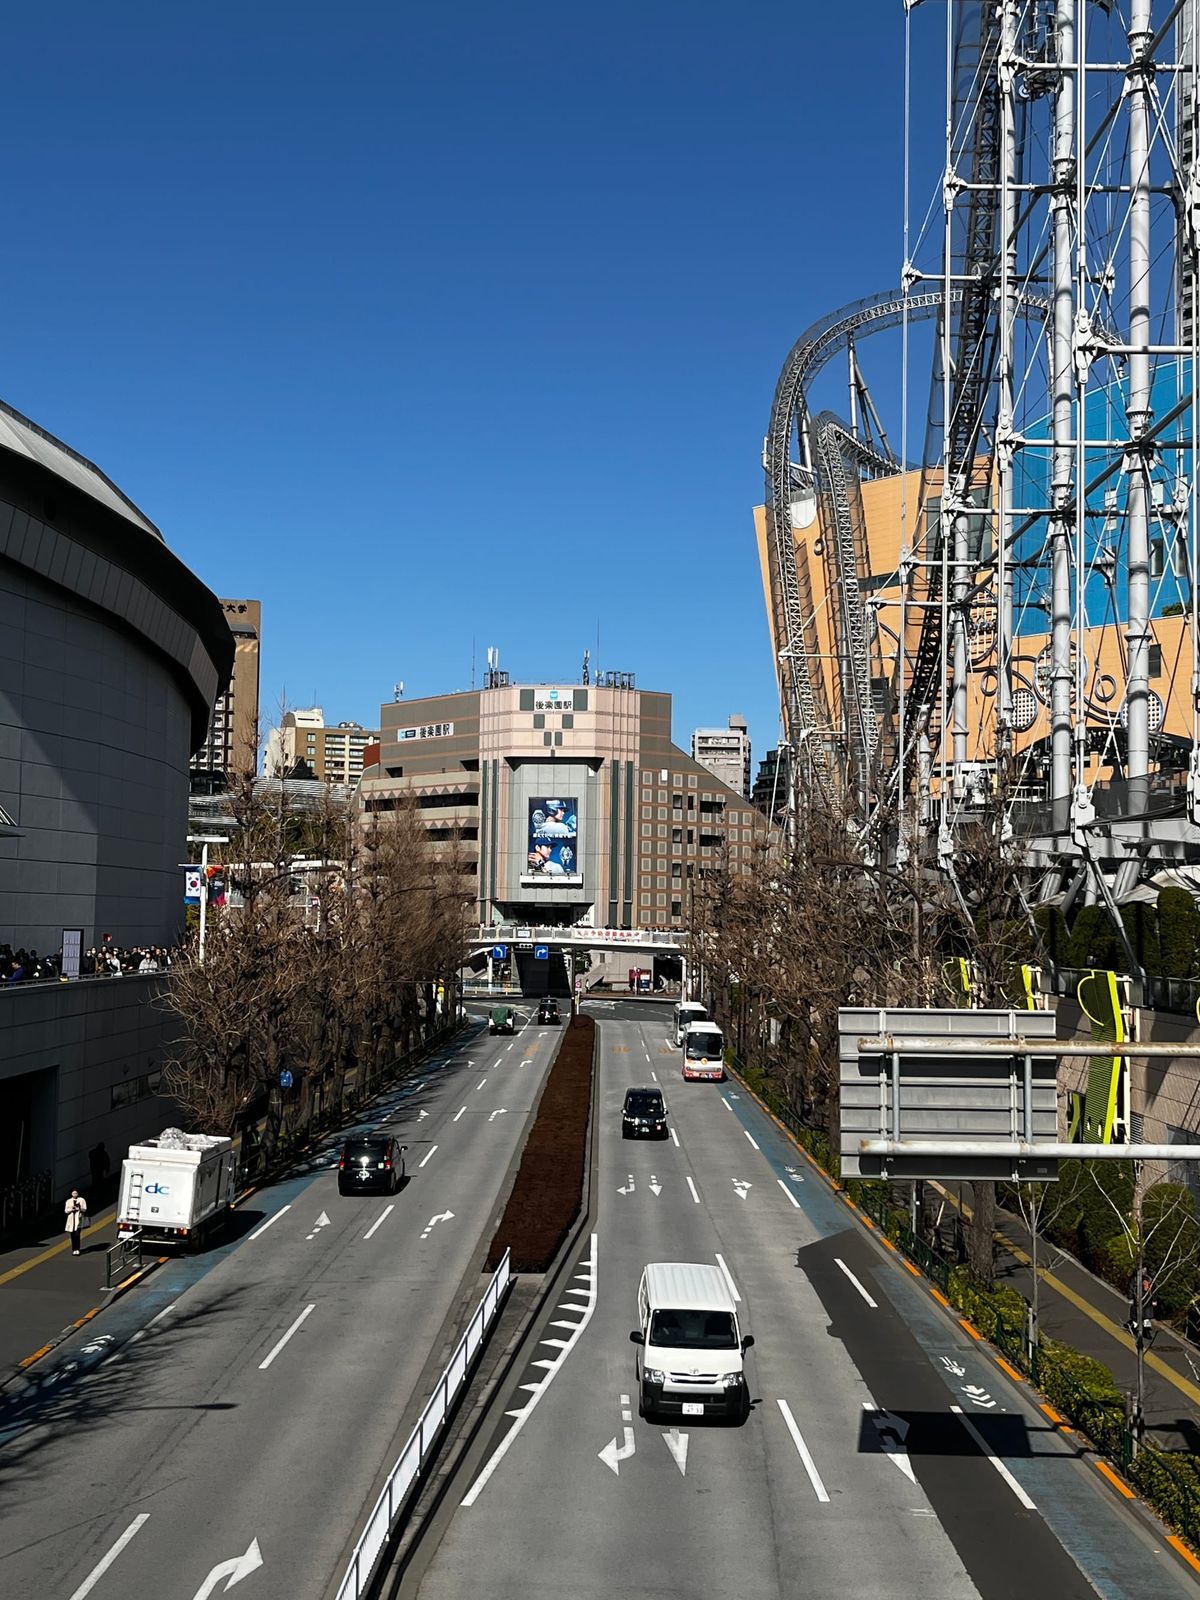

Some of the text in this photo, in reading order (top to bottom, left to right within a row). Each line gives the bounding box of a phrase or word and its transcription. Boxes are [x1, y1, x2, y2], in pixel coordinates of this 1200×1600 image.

[536, 700, 572, 710] 後楽園駅
[420, 723, 450, 738] 後楽園駅
[145, 1183, 170, 1195] dc
